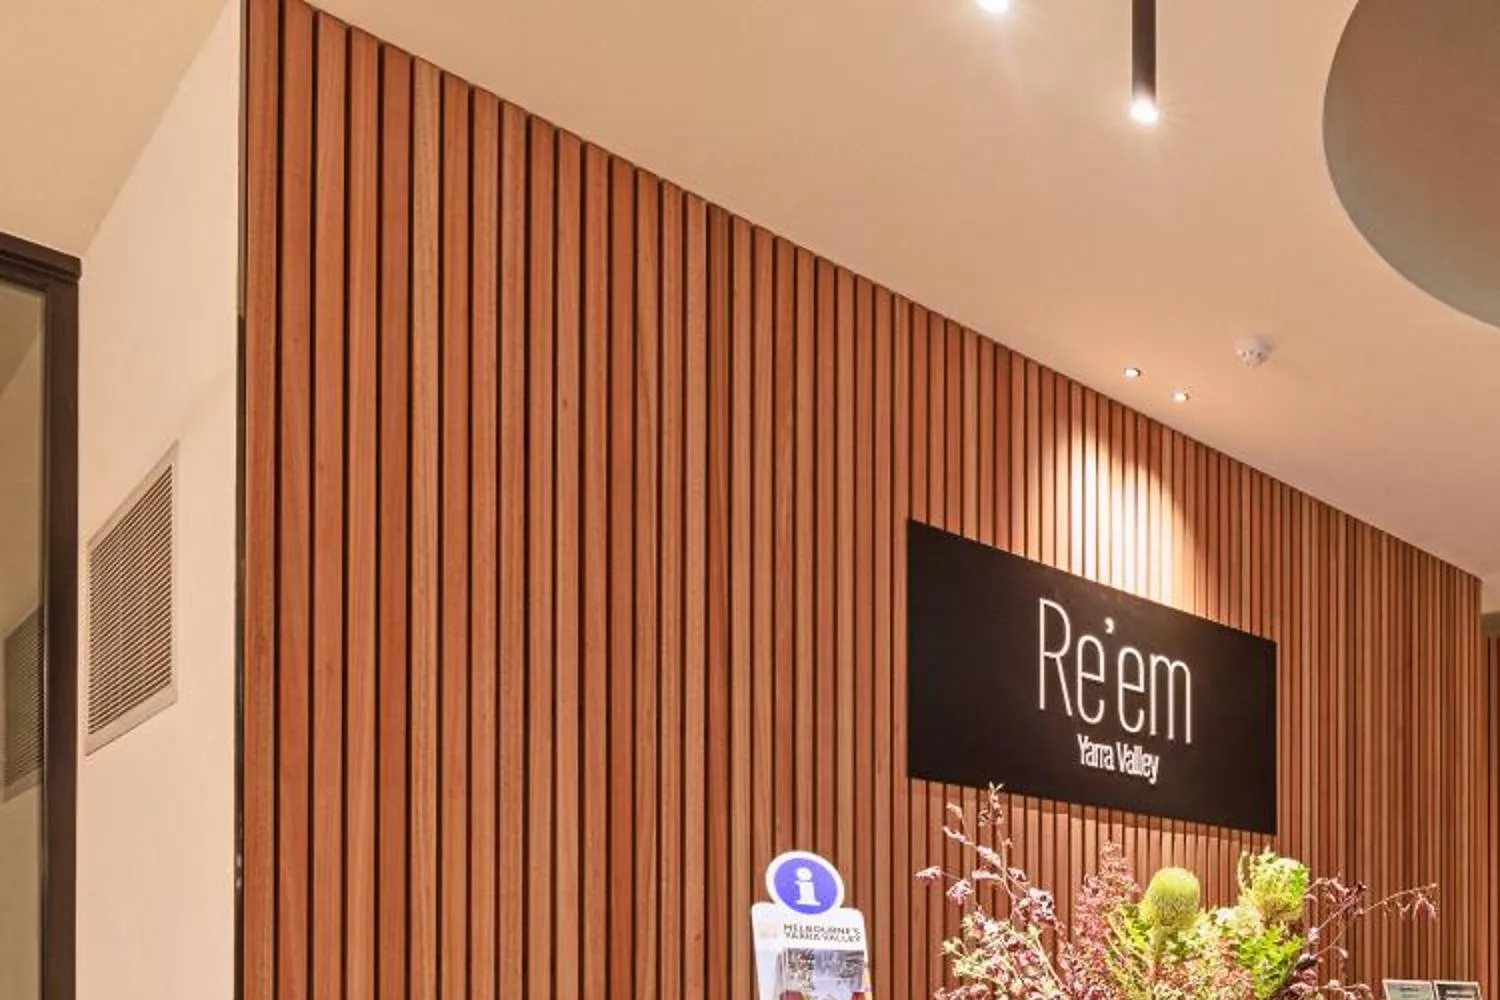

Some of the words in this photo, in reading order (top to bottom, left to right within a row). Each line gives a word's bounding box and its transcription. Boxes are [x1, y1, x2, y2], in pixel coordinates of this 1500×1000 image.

[1039, 598, 1191, 744] Re'em
[1076, 733, 1115, 771] Yarra
[1116, 741, 1159, 784] Valley
